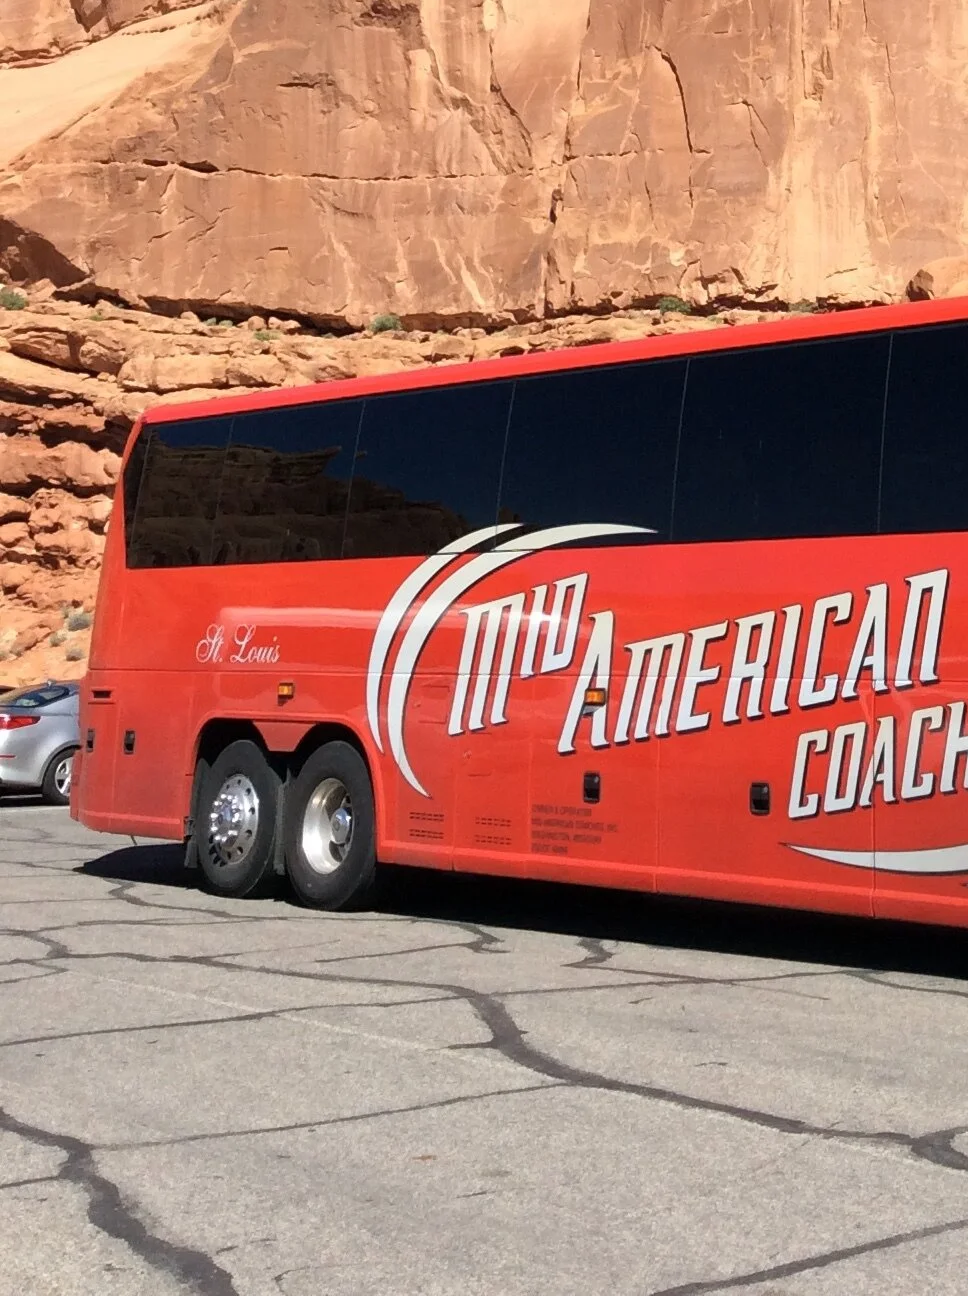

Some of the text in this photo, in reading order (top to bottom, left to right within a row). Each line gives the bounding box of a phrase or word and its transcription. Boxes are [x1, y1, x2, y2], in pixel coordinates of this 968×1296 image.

[195, 623, 281, 663] St. Louis
[447, 567, 949, 756] MID AMERICAN
